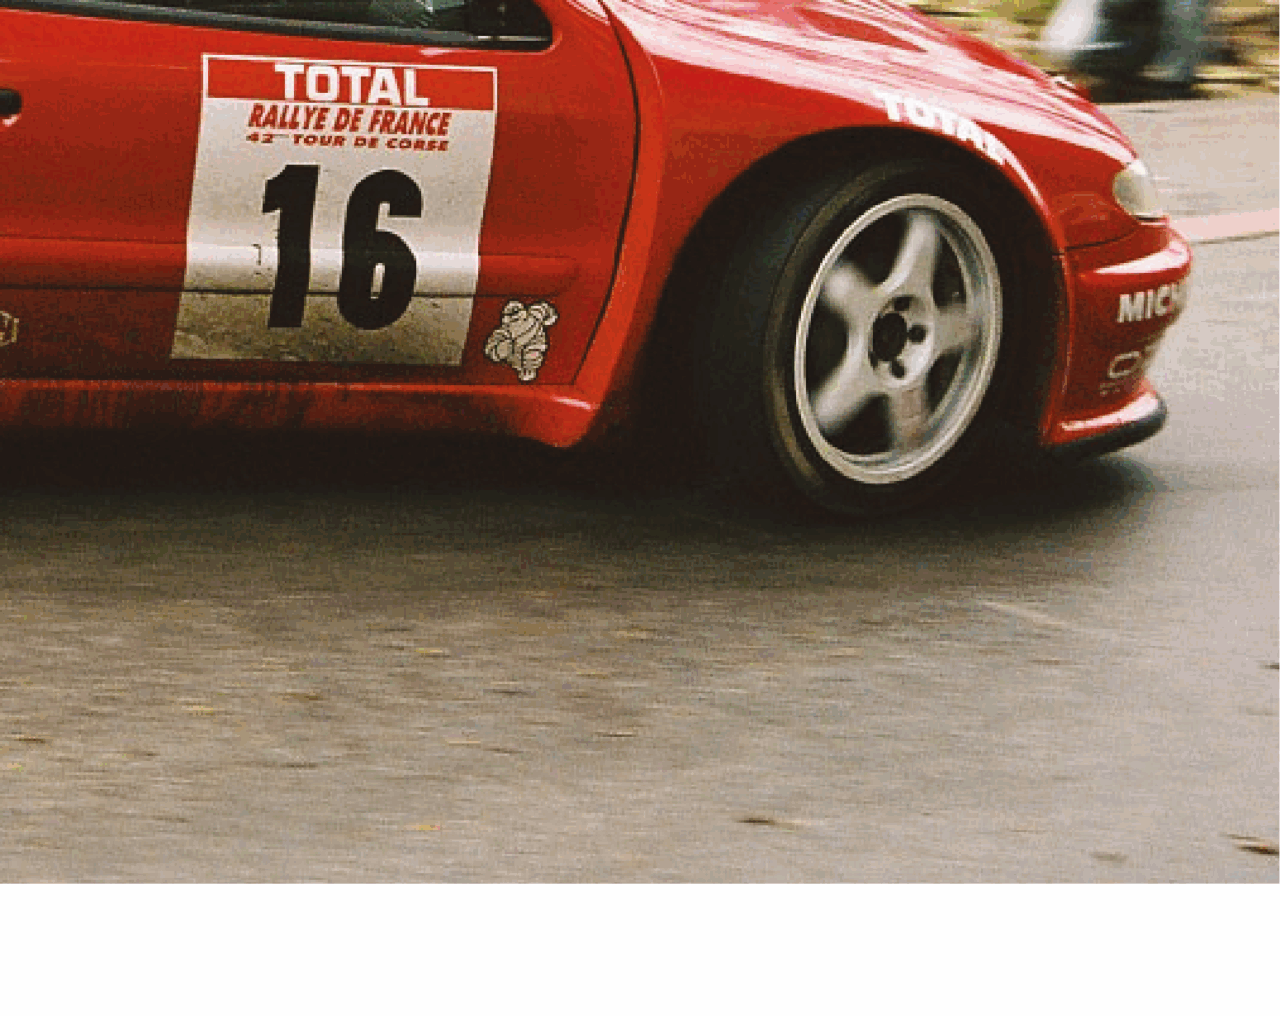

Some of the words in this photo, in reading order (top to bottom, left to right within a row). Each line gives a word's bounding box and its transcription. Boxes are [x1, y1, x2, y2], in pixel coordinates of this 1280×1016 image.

[274, 64, 430, 106] TOTAL
[248, 102, 331, 131] RALLYE
[333, 107, 364, 133] DE
[368, 110, 452, 136] FRANCE
[873, 89, 1004, 165] TOTAL
[293, 134, 346, 147] TOUR
[354, 137, 379, 149] DE
[385, 138, 450, 152] CORSE
[262, 164, 423, 330] 16
